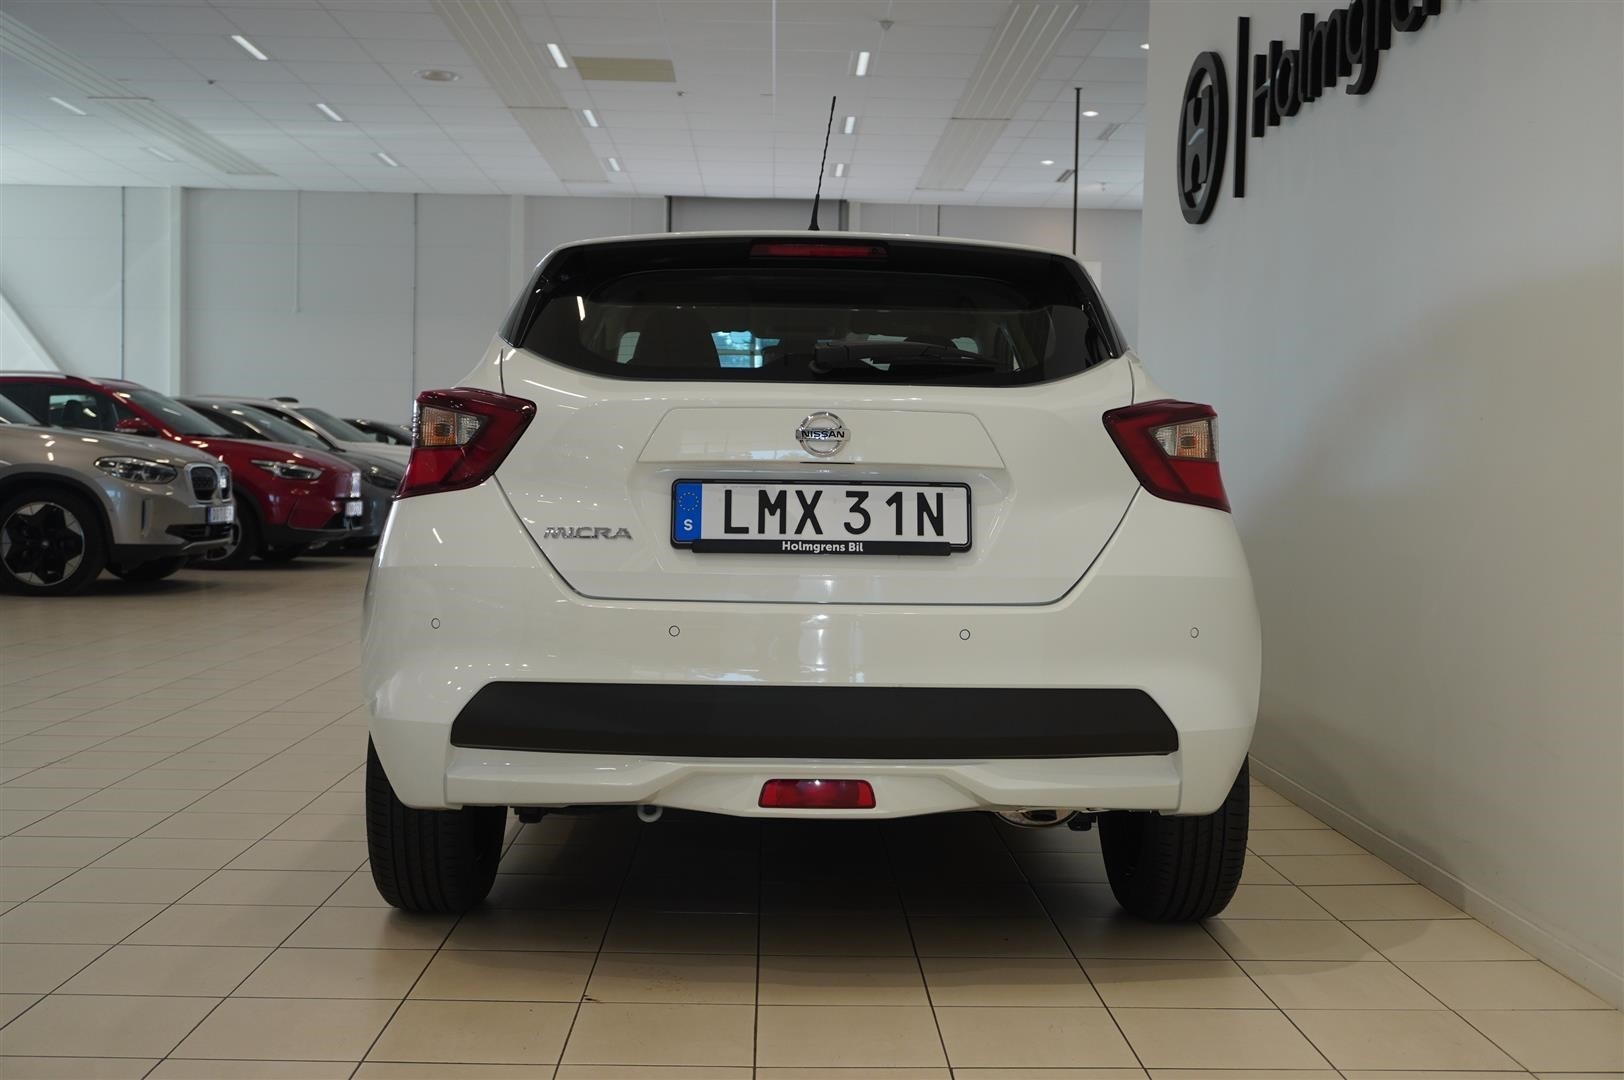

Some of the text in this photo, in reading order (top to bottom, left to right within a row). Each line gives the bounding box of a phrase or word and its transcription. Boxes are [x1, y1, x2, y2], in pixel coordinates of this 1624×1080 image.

[801, 430, 845, 438] NISSAN
[724, 489, 944, 537] LMX 31N
[683, 518, 693, 531] S
[544, 527, 633, 540] MICRA
[782, 541, 864, 554] Holmgrens Bil
